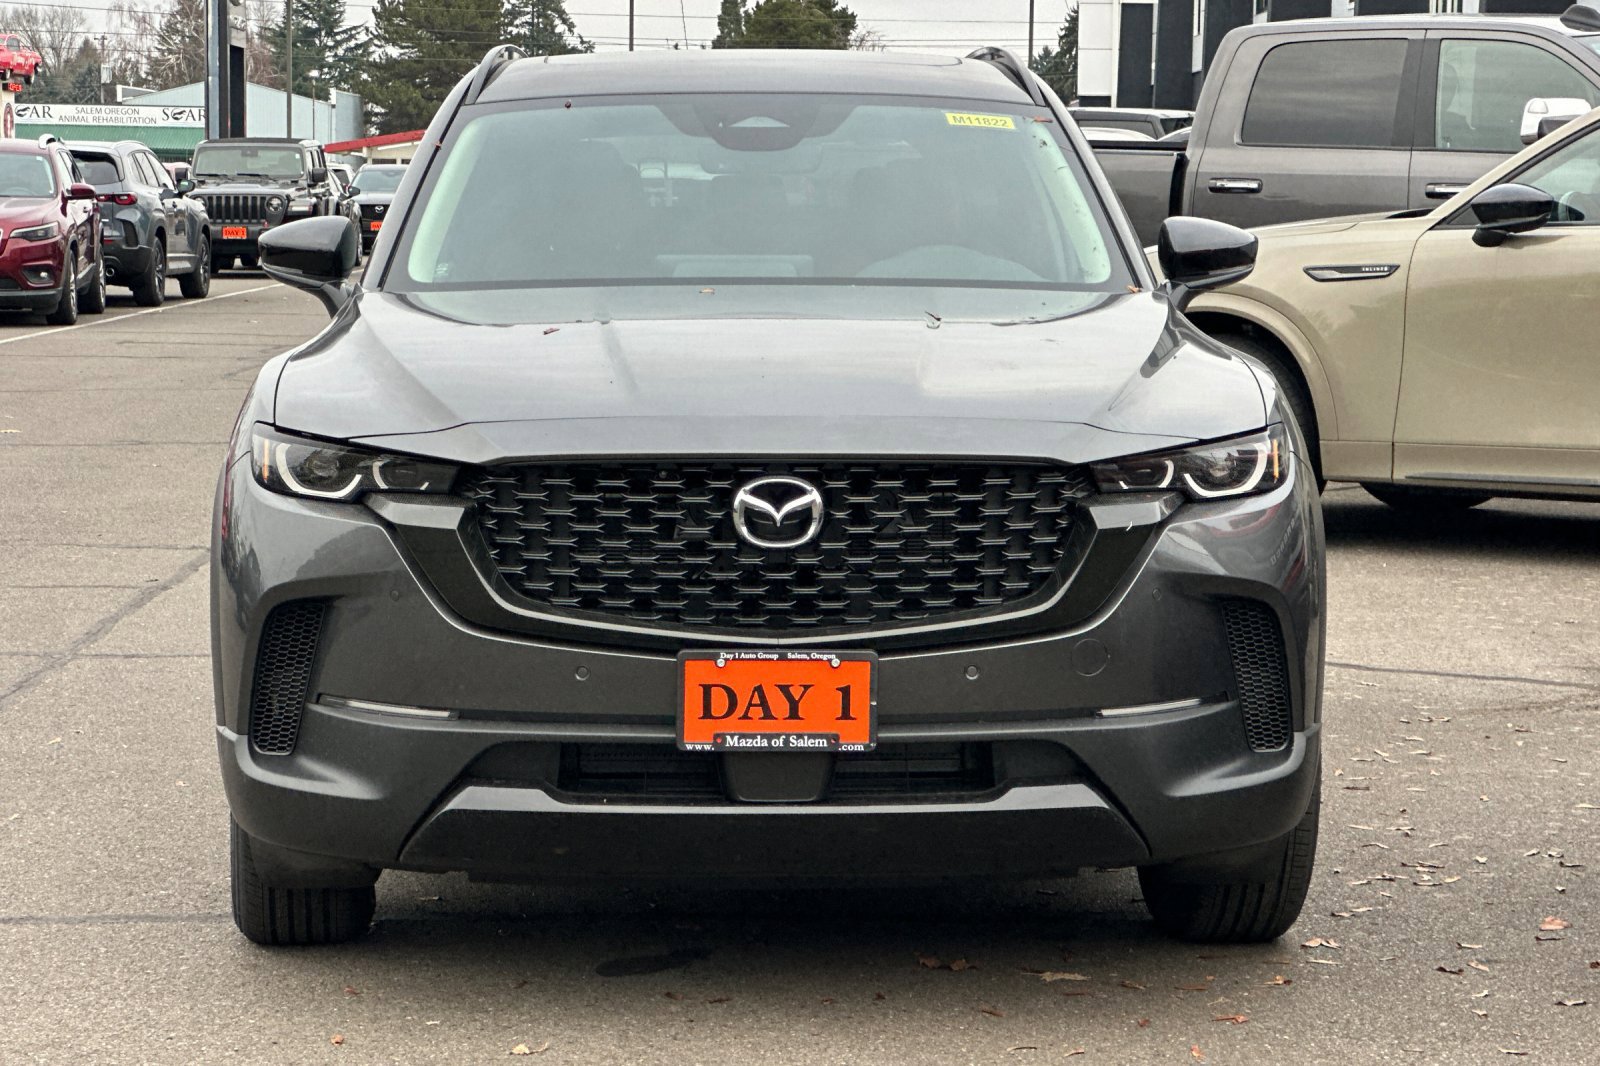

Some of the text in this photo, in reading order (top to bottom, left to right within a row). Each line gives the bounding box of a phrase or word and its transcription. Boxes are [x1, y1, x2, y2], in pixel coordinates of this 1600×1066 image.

[75, 106, 140, 116] SALEM OREGON
[58, 115, 157, 124] ANIMAL REHABILITATION
[952, 115, 1009, 127] M11822
[720, 652, 734, 661] Day
[757, 652, 779, 661] Group
[787, 652, 810, 660] Salem,
[810, 652, 836, 661] Oregon
[698, 683, 857, 721] DAY 1
[685, 735, 865, 751] www. Mazda of Salem .com
